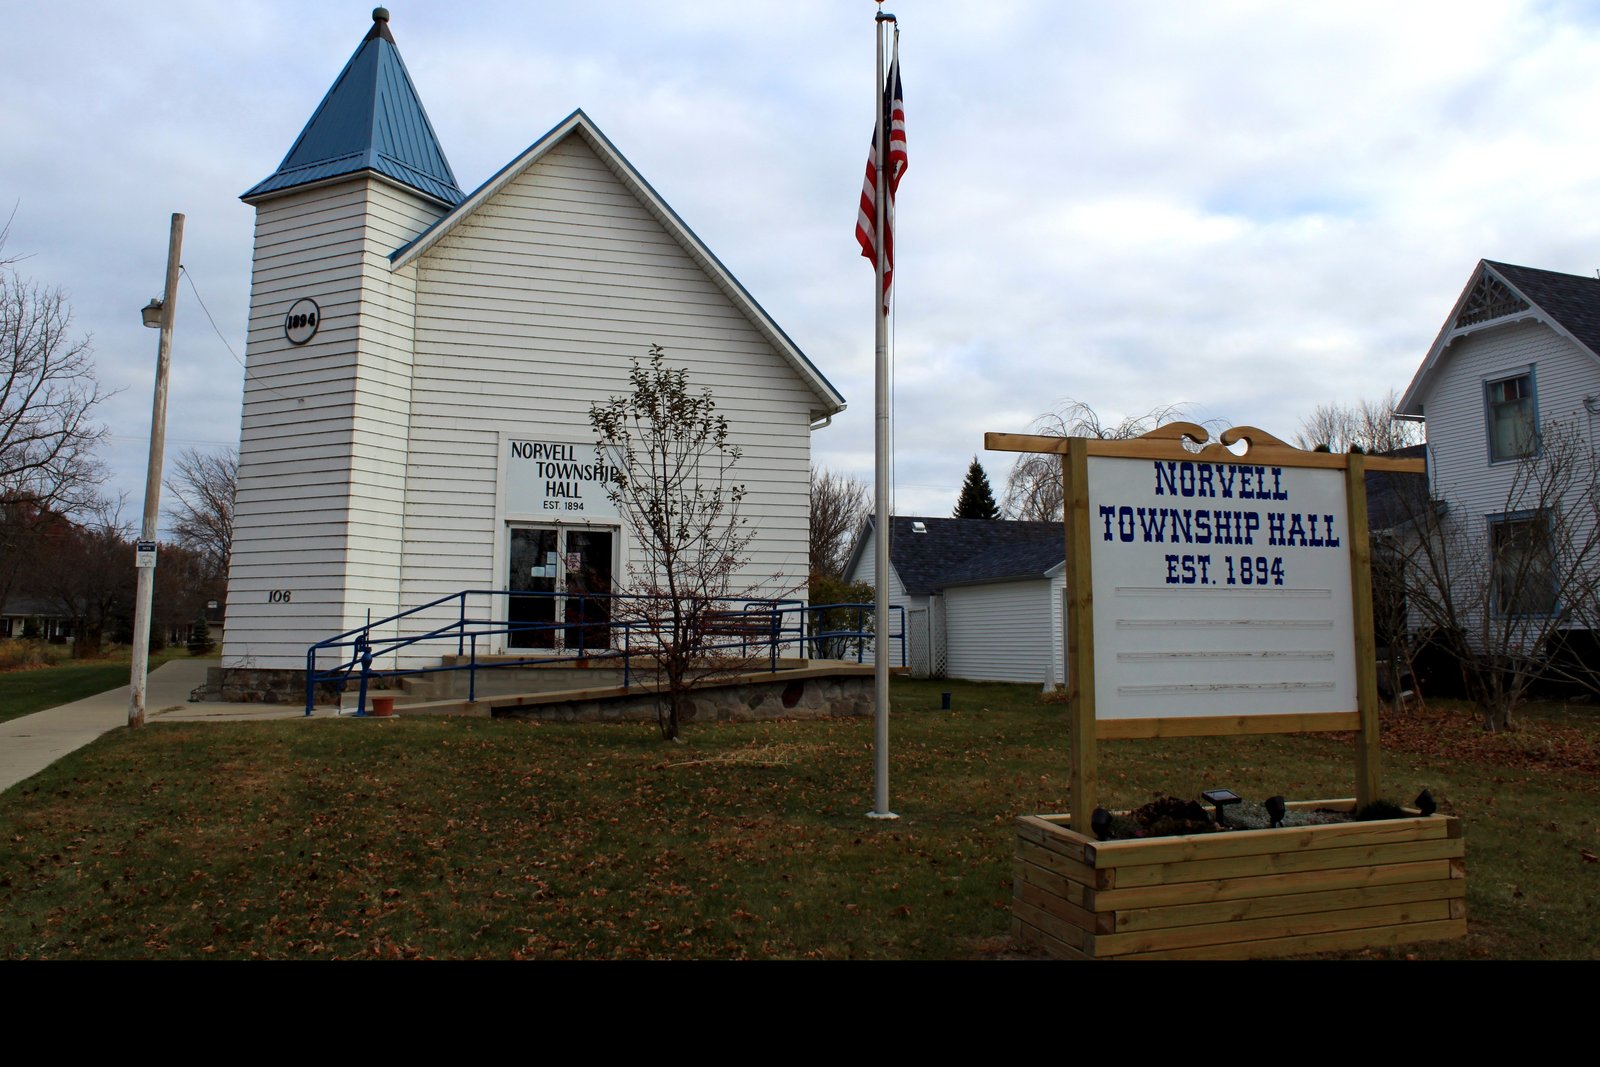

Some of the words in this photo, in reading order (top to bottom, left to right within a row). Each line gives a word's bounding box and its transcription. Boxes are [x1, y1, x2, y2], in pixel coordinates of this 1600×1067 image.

[288, 312, 315, 329] 1894
[511, 442, 577, 461] NORVELL
[536, 462, 620, 482] TOWNSHIP
[1154, 461, 1288, 500] NORVELL
[546, 481, 582, 498] HALL
[543, 500, 561, 510] EST.
[565, 502, 584, 511] 1894
[1099, 505, 1260, 545] TOWNSHIP
[1267, 512, 1340, 548] HALL
[1165, 554, 1217, 585] EST.
[1225, 556, 1285, 585] 1894
[268, 590, 291, 602] 106
